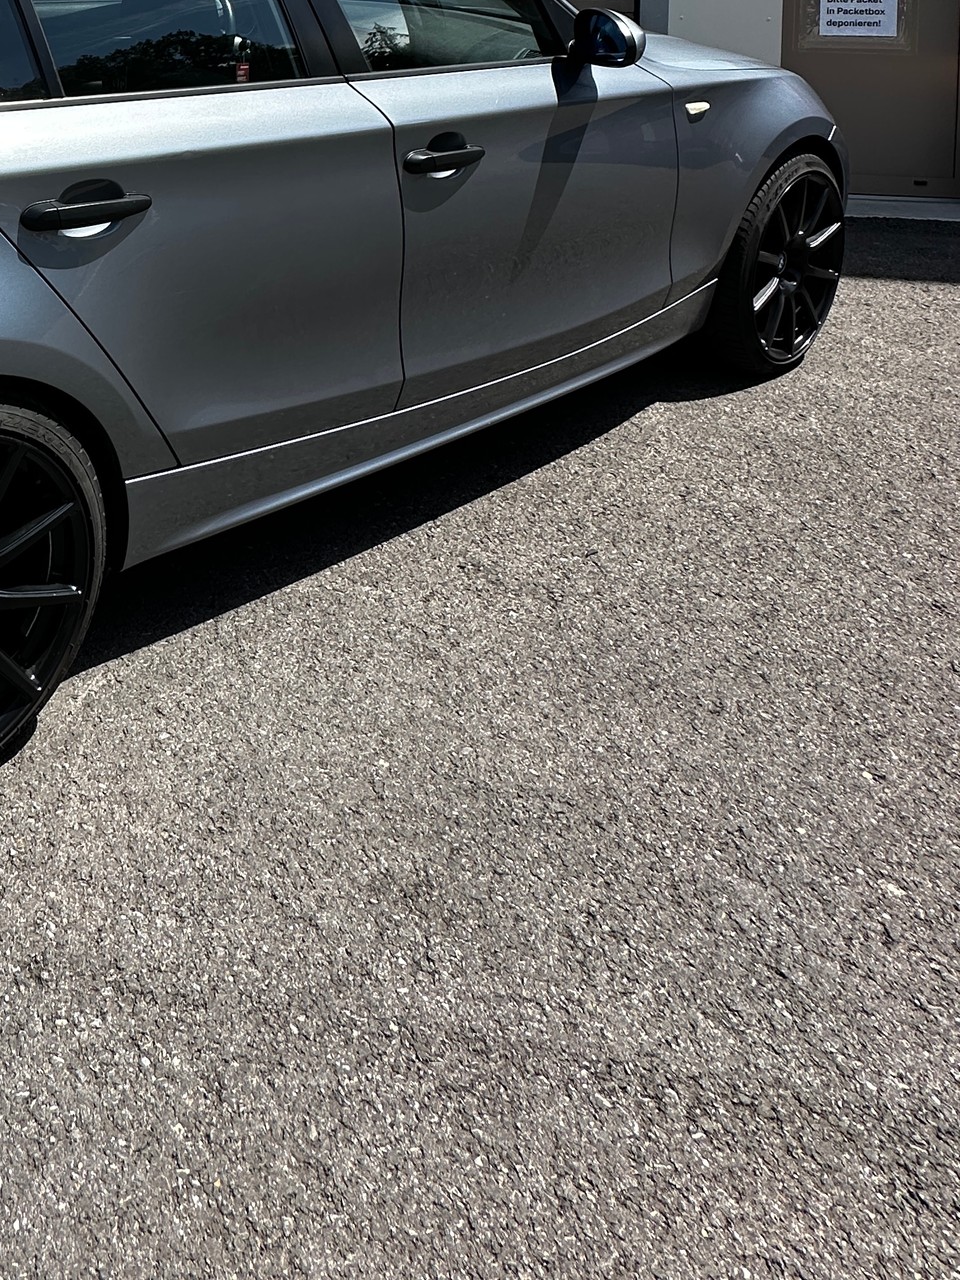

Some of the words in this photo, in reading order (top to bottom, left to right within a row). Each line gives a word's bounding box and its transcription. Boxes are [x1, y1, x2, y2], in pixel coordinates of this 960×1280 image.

[826, 7, 835, 15] in
[837, 7, 886, 15] Packetbox
[826, 19, 881, 27] deponieren!
